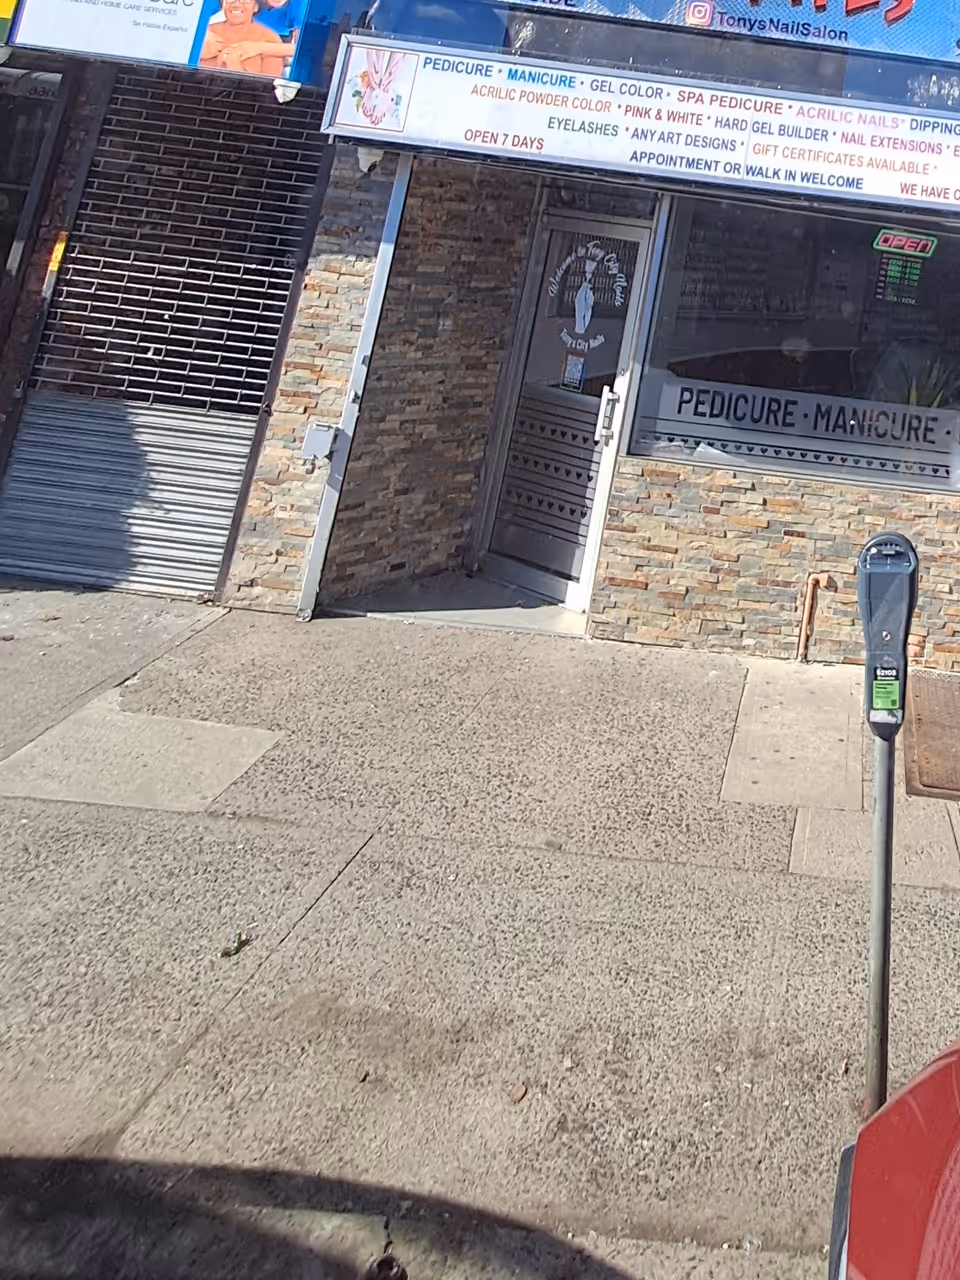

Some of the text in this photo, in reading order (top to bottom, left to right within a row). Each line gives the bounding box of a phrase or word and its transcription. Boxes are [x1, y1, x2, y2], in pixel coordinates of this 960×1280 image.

[717, 11, 849, 41] TonysNailSalon
[422, 56, 493, 78] PEDICURE
[507, 68, 577, 89] MANICURE
[590, 78, 615, 94] GEL
[619, 82, 664, 100] COLOR
[677, 90, 704, 105] SPA
[709, 94, 783, 115] PEDICURE
[796, 105, 853, 123] ACRILIC
[464, 128, 544, 150] OPEN 7 DAYS
[471, 84, 516, 101] ACRILIC
[519, 90, 569, 108] POWDER
[572, 97, 612, 113] COLOR
[624, 104, 651, 120] PINK
[655, 108, 663, 121] &
[667, 110, 703, 126] WHITE
[715, 116, 748, 131] HARD
[751, 121, 775, 135] GEL
[778, 126, 829, 142] BUILDER
[840, 131, 866, 146] NAIL
[870, 135, 943, 155] EXTENSIONS
[548, 117, 930, 175] EYELASHES ANY ART DESIGNS GIFT CERTIFICATES AVAILABLE
[629, 150, 864, 189] APPOINTMENT OR WALK IN WELCOME
[900, 182, 917, 196] WE
[921, 185, 950, 199] HAVE
[879, 234, 932, 252] OPEN
[678, 387, 798, 427] PEDICURE
[813, 403, 937, 444] MANICURE
